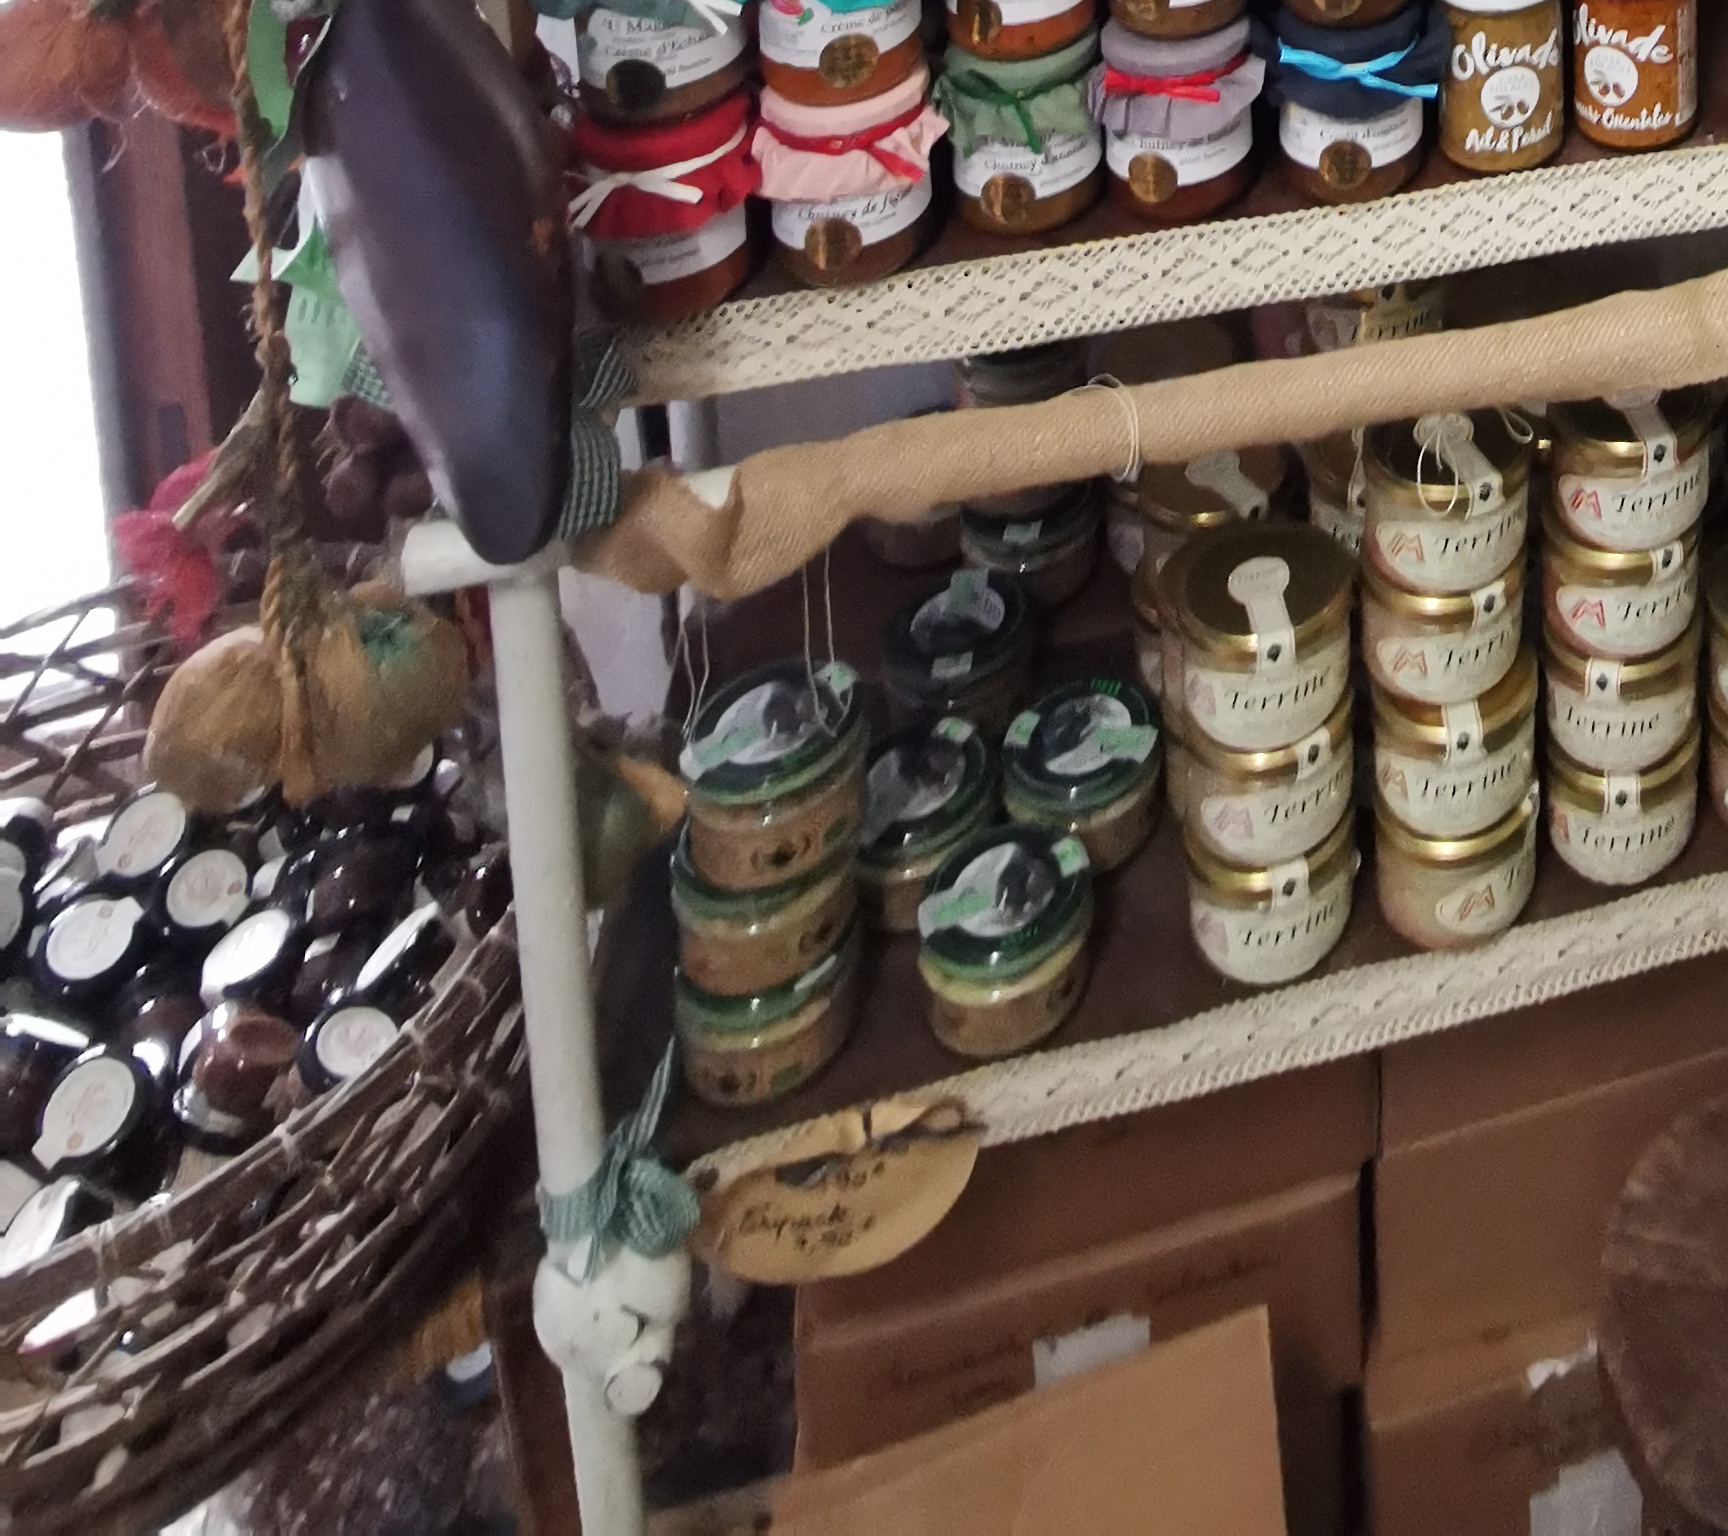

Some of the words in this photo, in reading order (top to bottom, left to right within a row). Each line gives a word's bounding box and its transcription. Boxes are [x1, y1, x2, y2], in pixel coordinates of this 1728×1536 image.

[1610, 468, 1704, 514] Terrine
[1434, 507, 1528, 555] Terrin
[1223, 662, 1334, 710] Terrine
[1415, 751, 1520, 799] Terrine
[1577, 813, 1678, 850] Terrine
